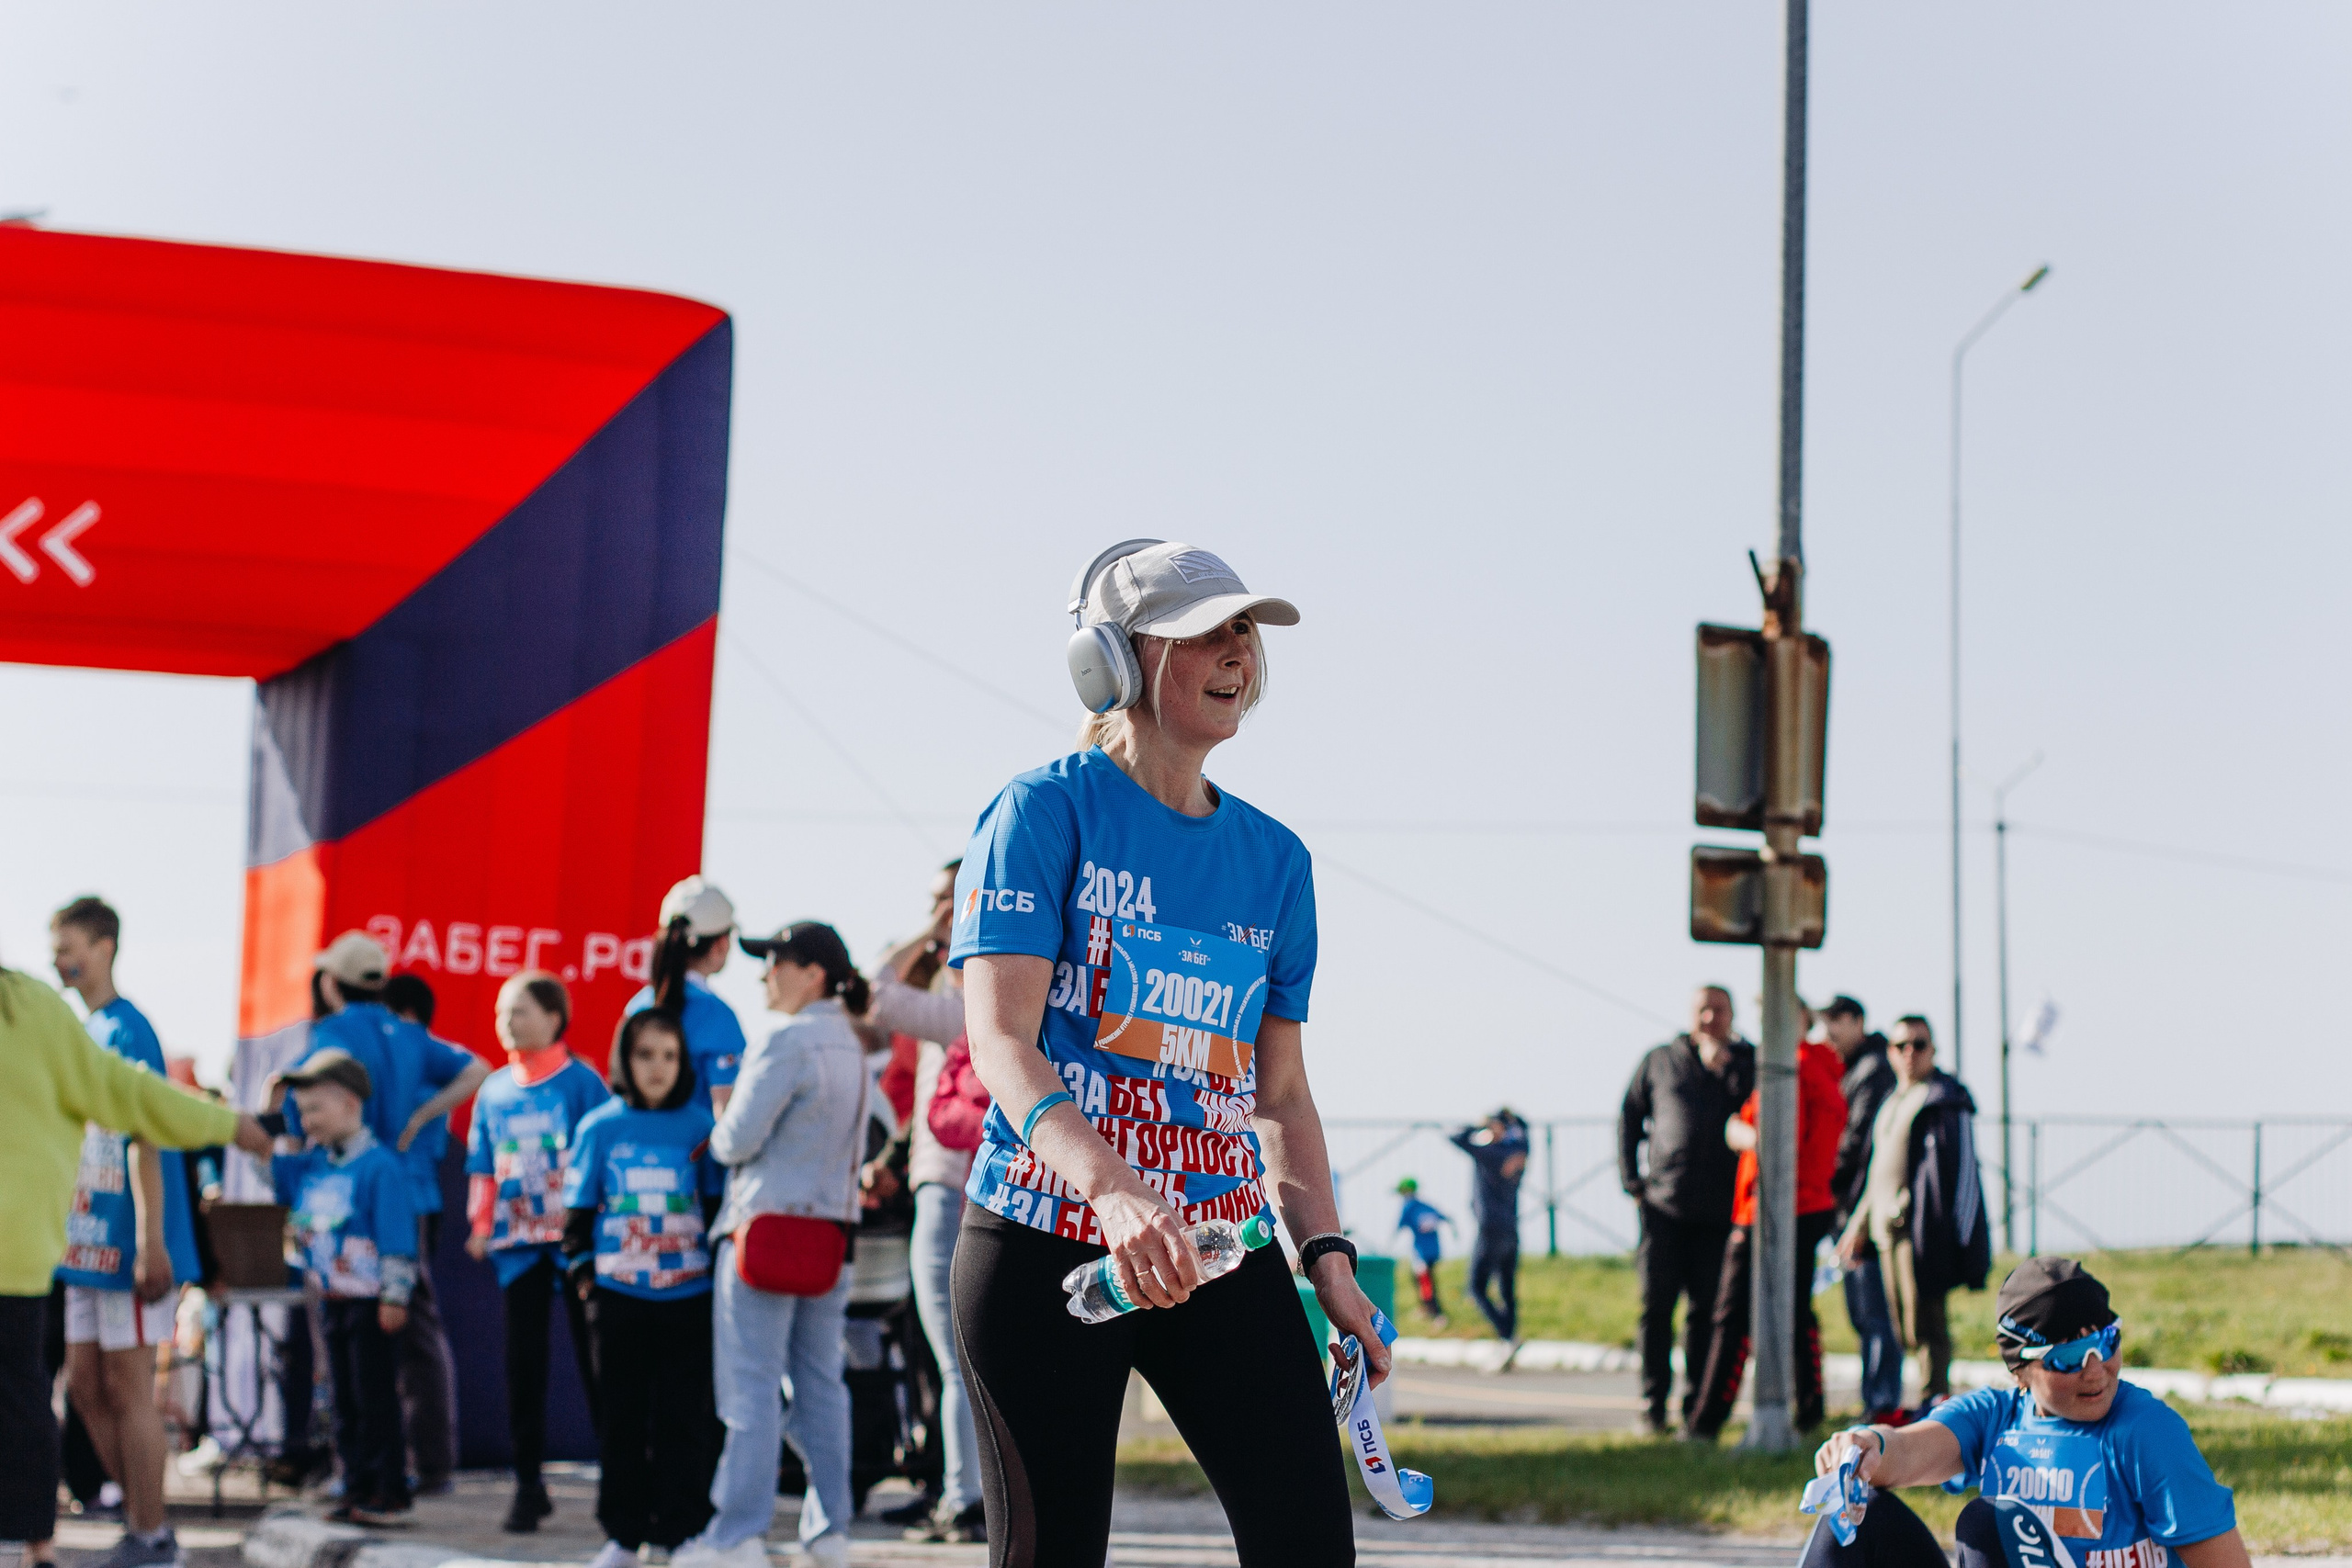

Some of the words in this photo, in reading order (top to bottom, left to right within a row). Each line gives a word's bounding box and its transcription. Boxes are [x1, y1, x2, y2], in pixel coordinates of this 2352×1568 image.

[979, 888, 1035, 913] ПСБ
[1077, 860, 1157, 923] 2024
[1137, 928, 1162, 942] ПСБ
[1142, 968, 1234, 1029] 20021
[985, 1183, 1108, 1246] #ЗАБЕ
[1357, 1418, 1378, 1454] ПСБ
[2007, 1466, 2075, 1502] 20010
